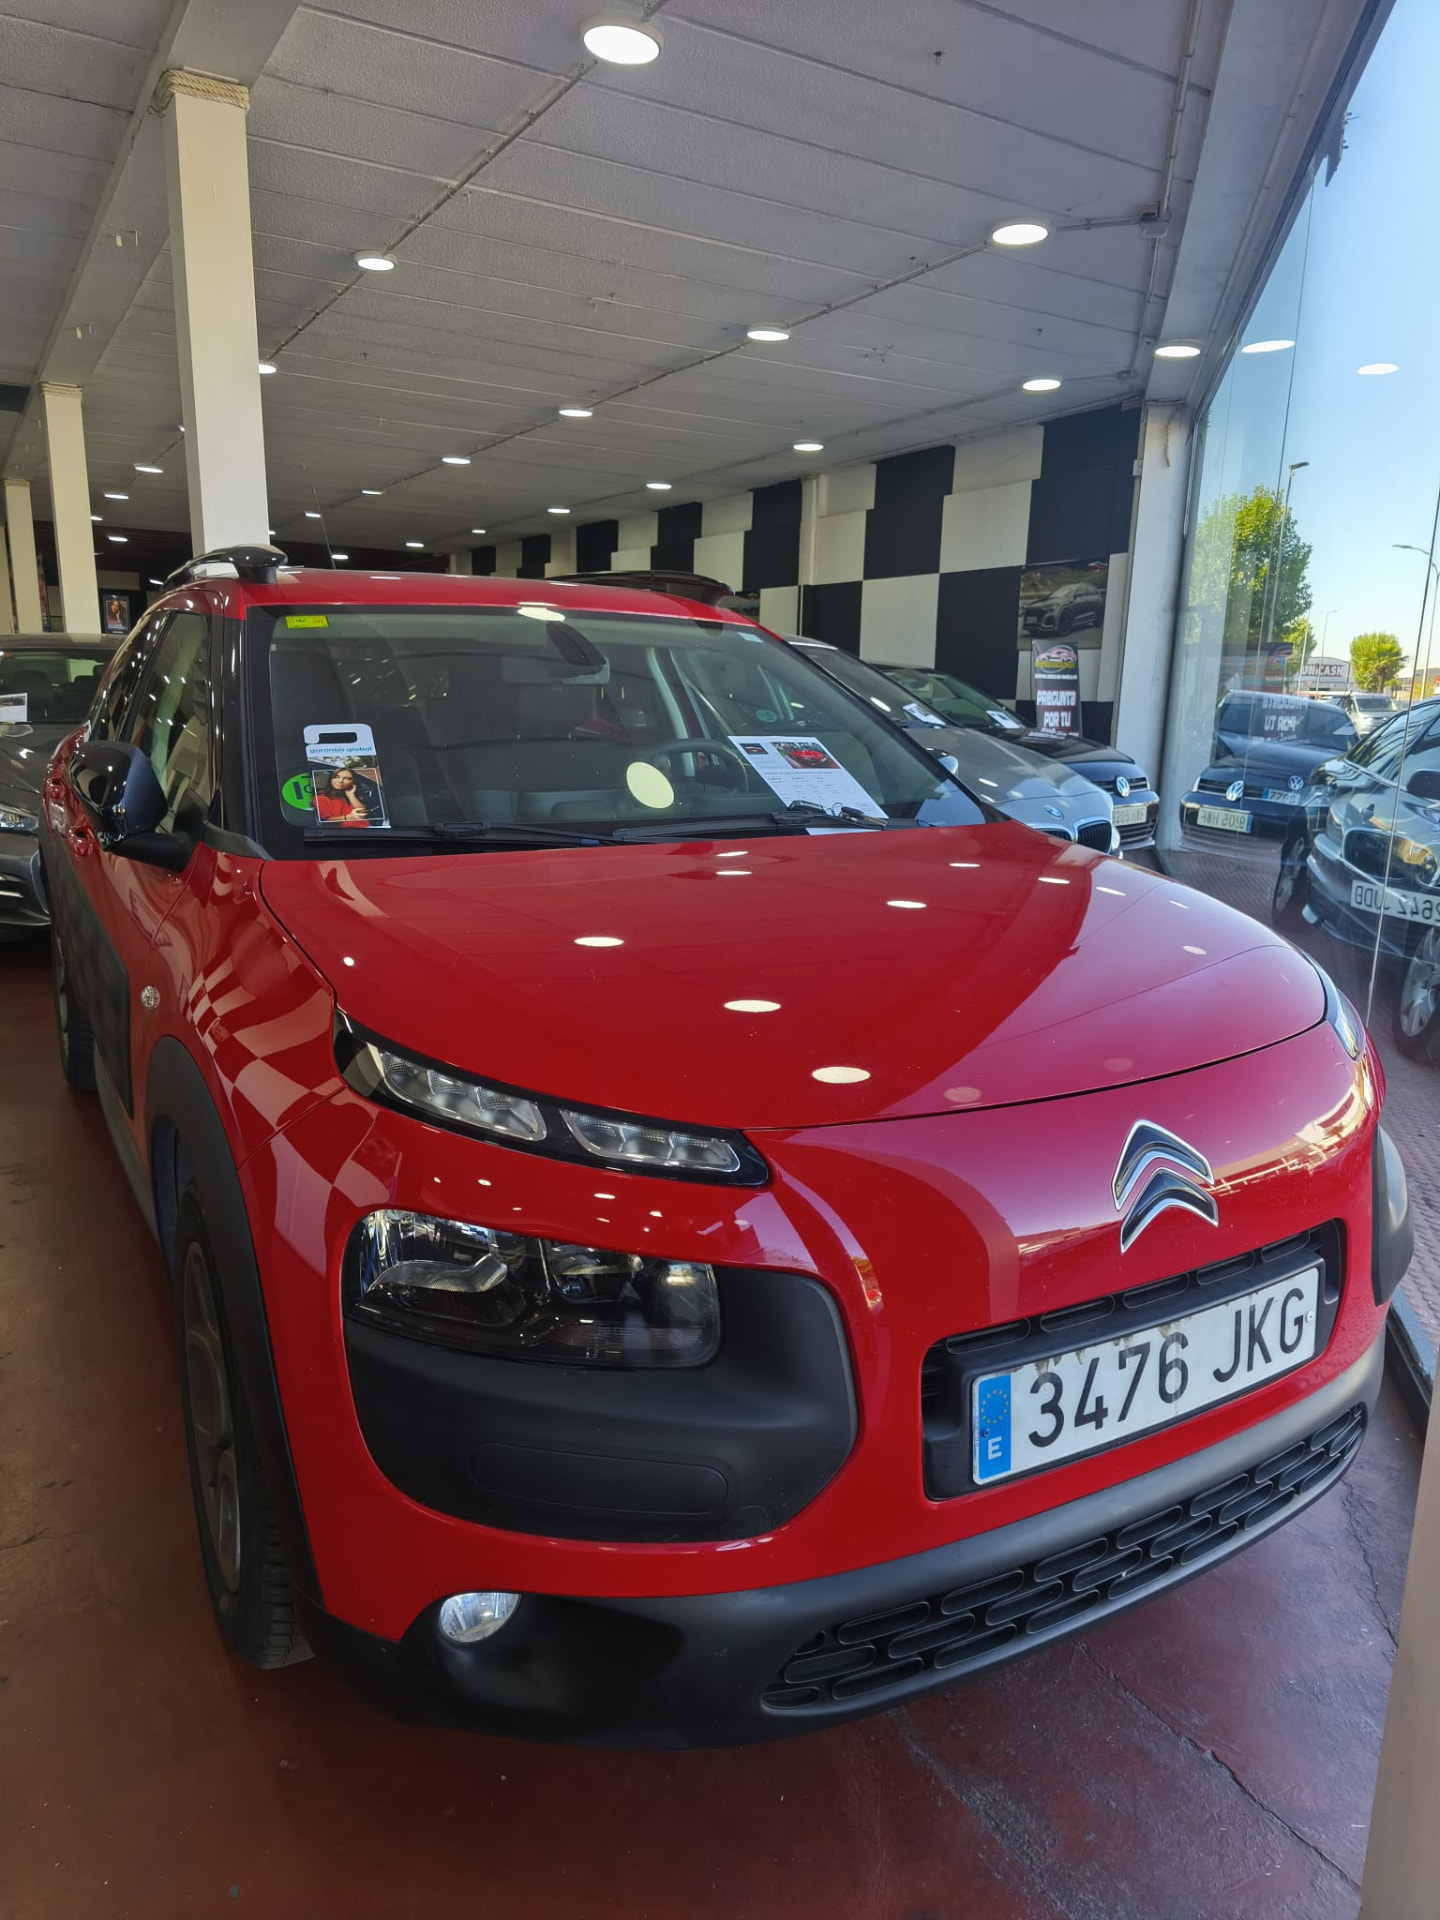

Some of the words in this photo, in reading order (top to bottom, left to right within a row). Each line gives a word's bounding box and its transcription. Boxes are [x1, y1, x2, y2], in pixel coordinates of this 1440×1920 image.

[1043, 711, 1060, 727] POR
[1060, 711, 1072, 727] TU
[988, 1437, 1002, 1460] E
[1028, 1332, 1189, 1448] 3476
[1212, 1288, 1305, 1383] JKG
